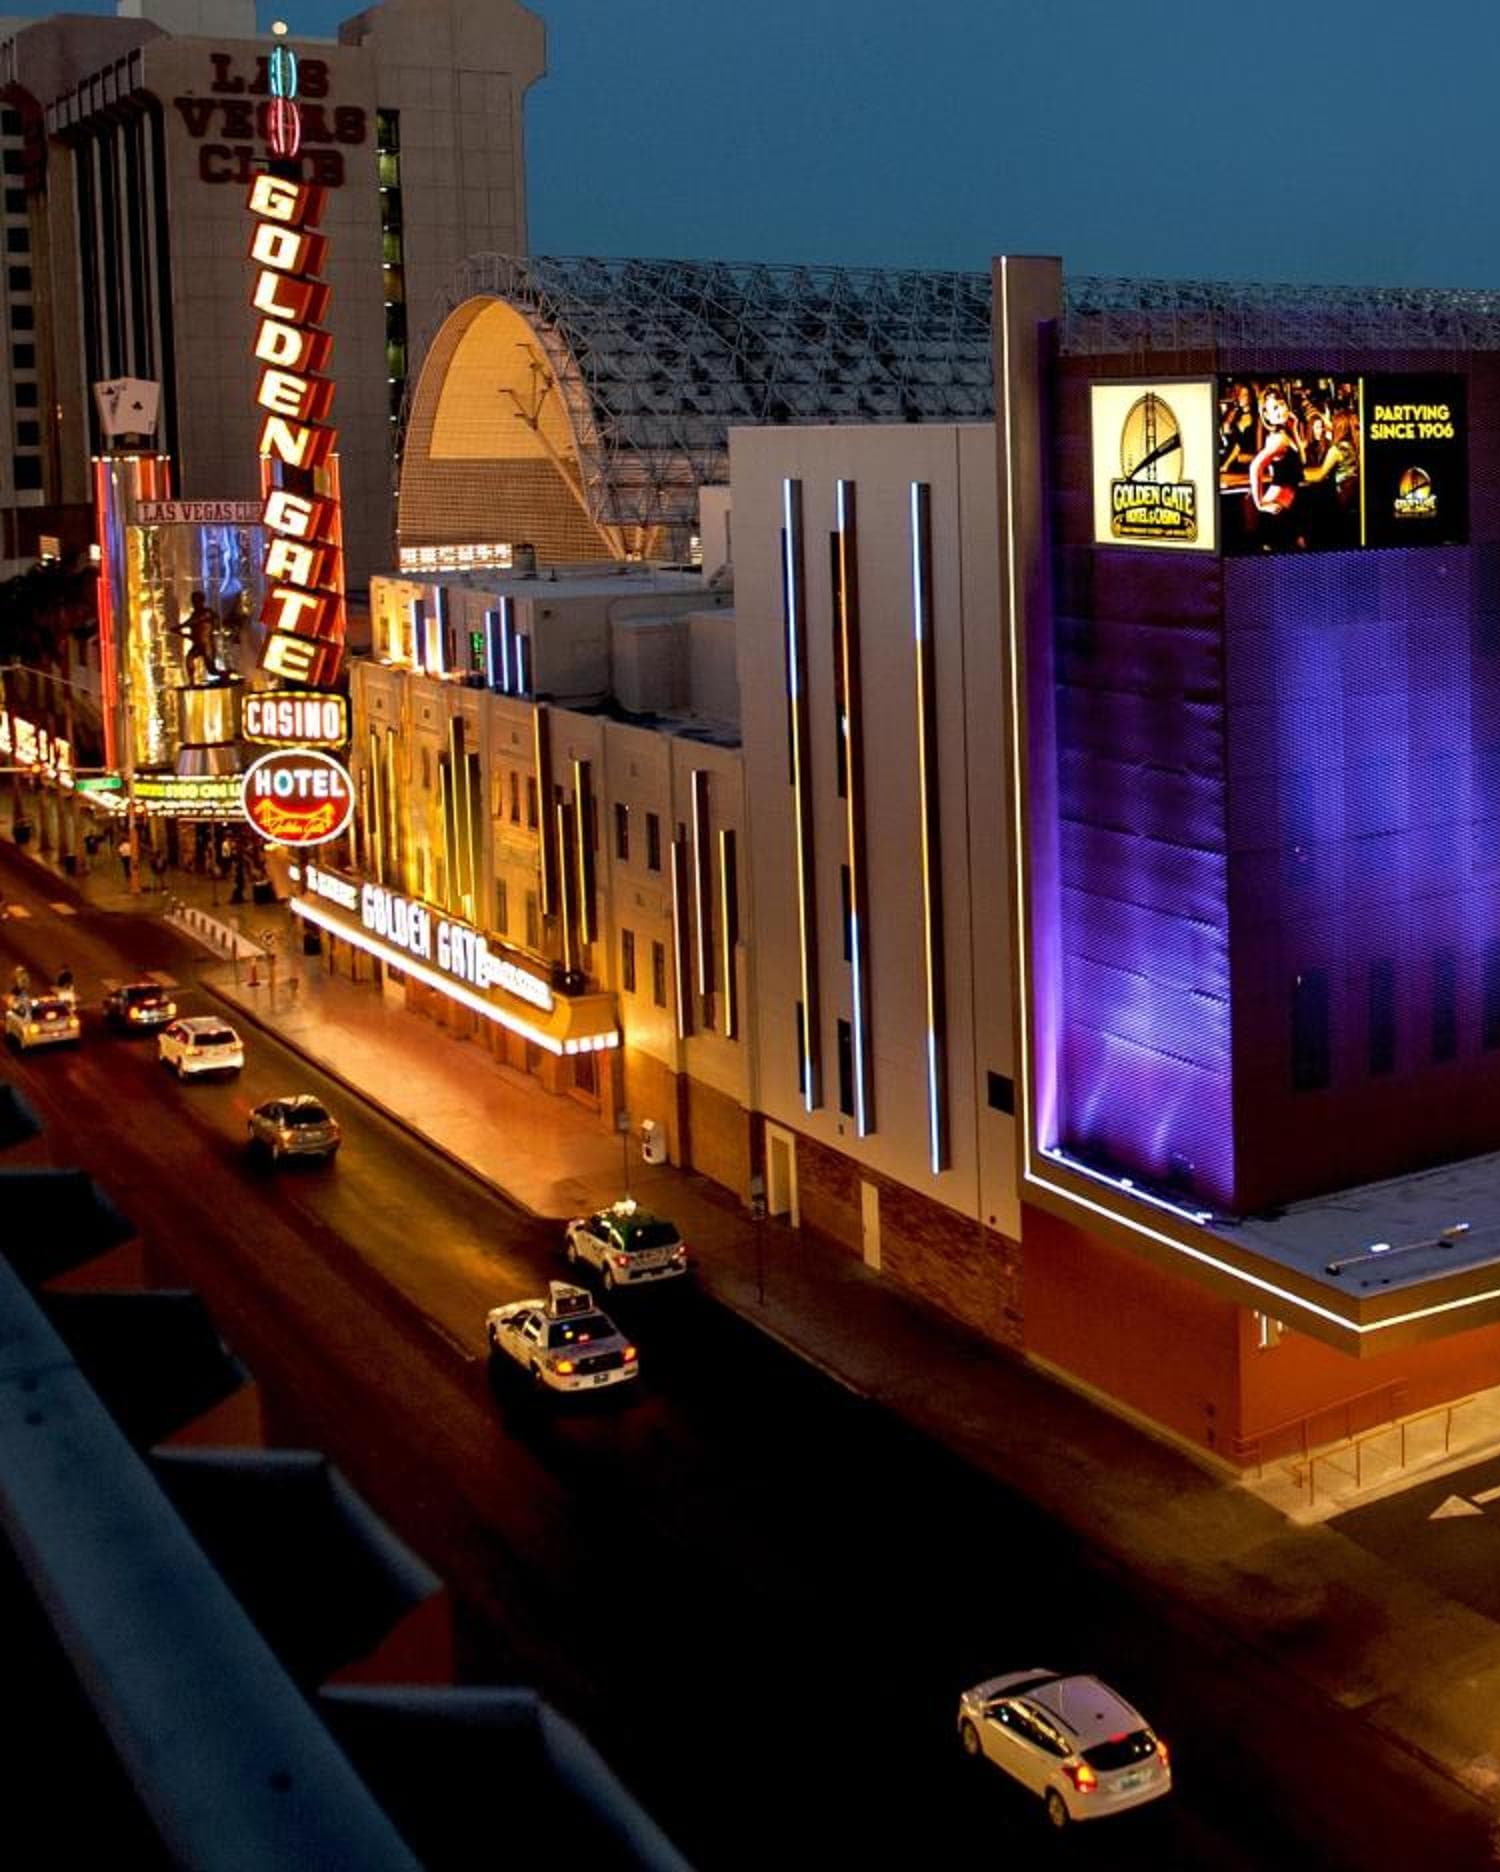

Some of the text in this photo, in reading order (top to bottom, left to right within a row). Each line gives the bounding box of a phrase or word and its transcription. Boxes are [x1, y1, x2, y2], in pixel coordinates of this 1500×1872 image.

[1375, 404, 1450, 421] PARTYING
[249, 175, 317, 682] GOLDEN GATE
[1370, 422, 1454, 439] SINCE 1906
[143, 503, 176, 521] LAS
[182, 503, 233, 521] VEGAS
[1113, 484, 1194, 517] GOLDEN GATE
[247, 701, 340, 739] CASINO
[255, 768, 346, 798] HOTEL
[361, 882, 431, 960] GOLDEN
[437, 919, 490, 989] GATE
